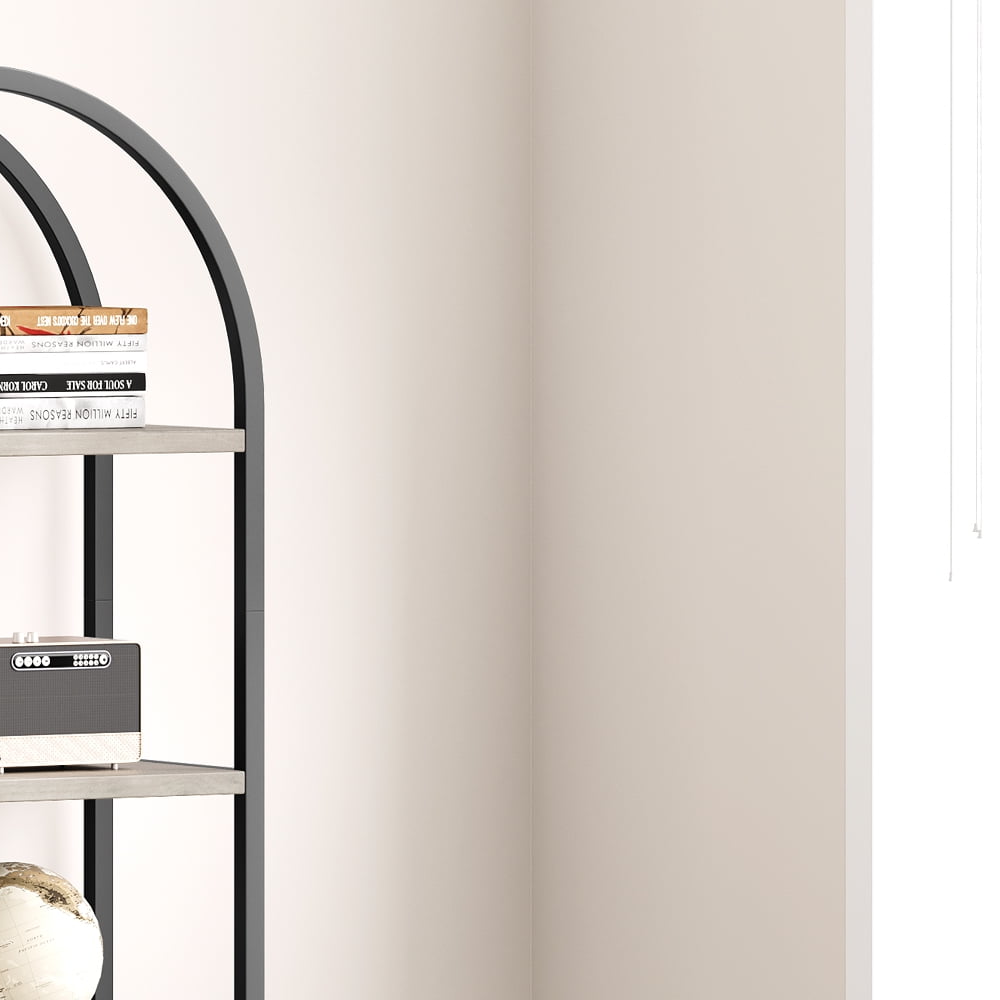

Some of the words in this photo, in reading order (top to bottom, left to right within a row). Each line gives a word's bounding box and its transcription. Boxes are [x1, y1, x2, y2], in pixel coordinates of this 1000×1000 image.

[37, 315, 51, 327] NEST
[80, 315, 92, 326] THE
[93, 315, 107, 326] OVER
[76, 340, 114, 348] MILLION
[21, 381, 48, 391] CAROL
[66, 380, 86, 391] SALE
[88, 380, 103, 390] FOR
[104, 380, 125, 389] SOUL
[30, 409, 72, 421] REASONS
[75, 408, 112, 420] MILLION
[115, 408, 138, 419] FIFTY
